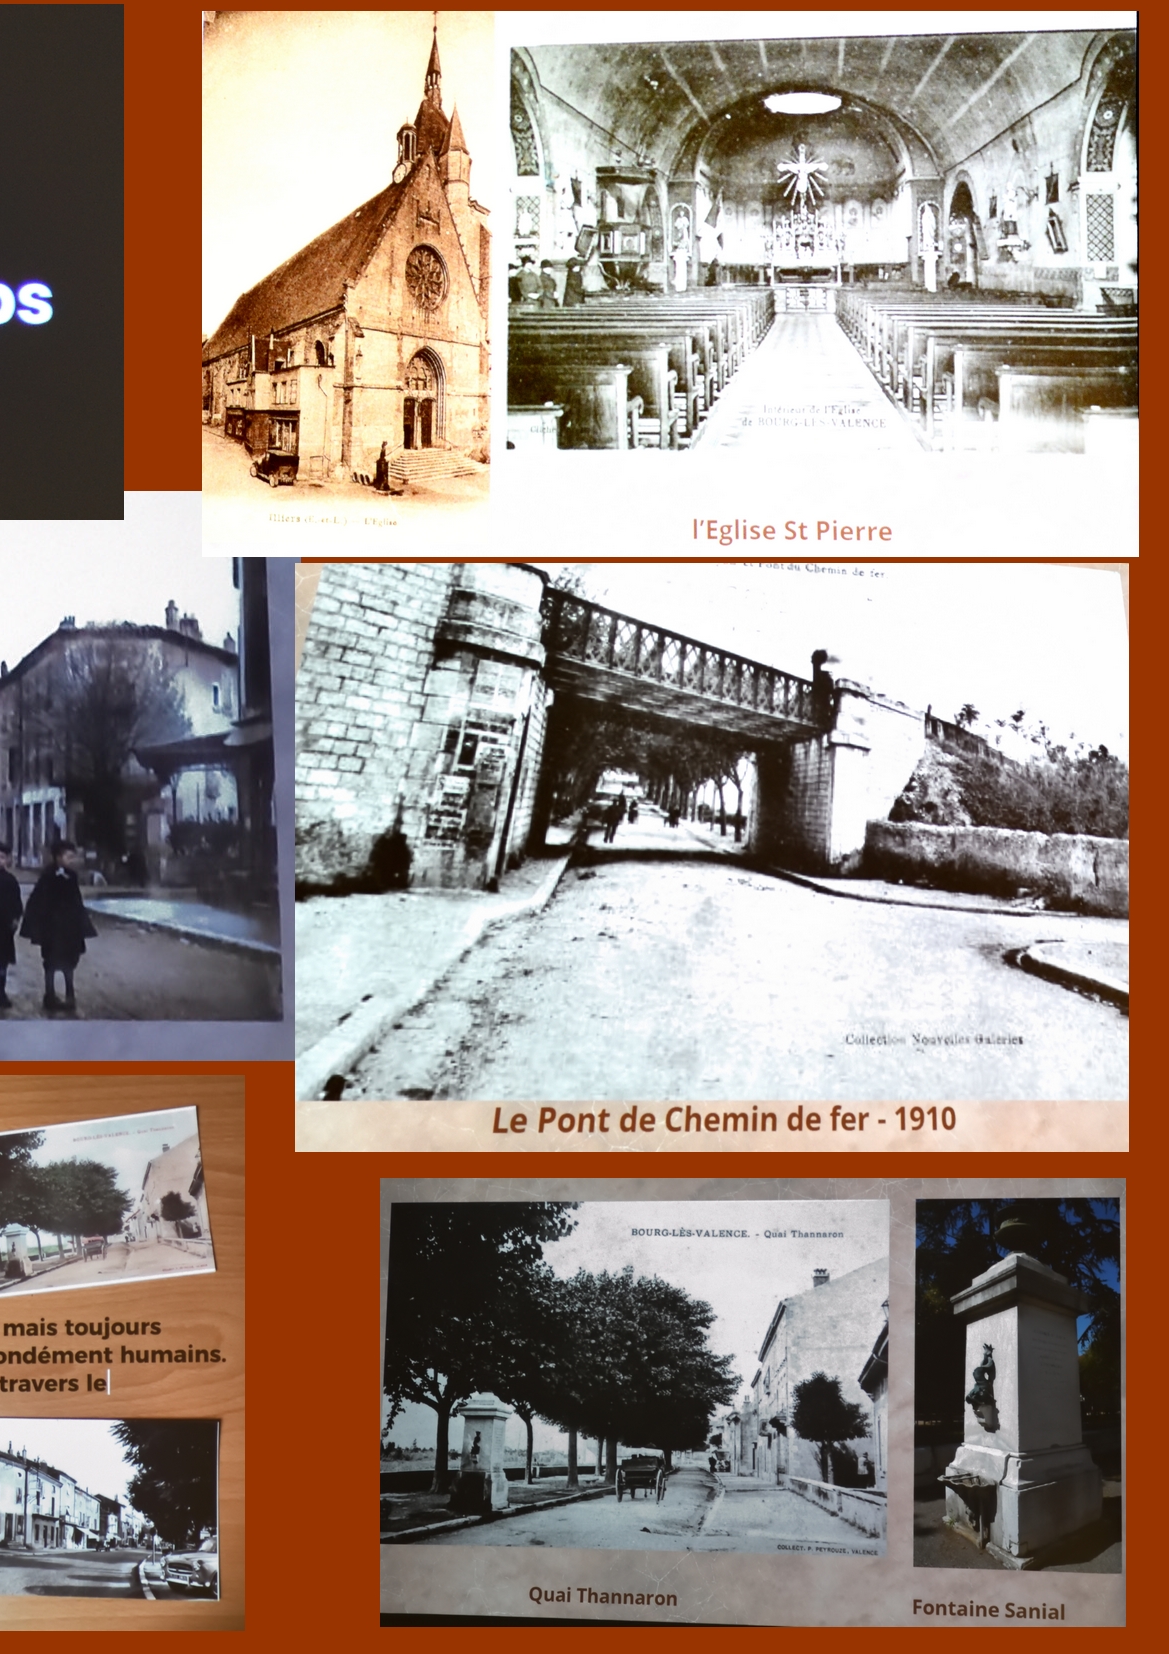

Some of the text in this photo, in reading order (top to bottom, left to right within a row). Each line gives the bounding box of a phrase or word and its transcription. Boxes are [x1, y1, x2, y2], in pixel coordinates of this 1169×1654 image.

[785, 520, 809, 541] St
[817, 520, 892, 542] Pierre
[492, 1108, 528, 1133] Le
[538, 1107, 610, 1133] Pont
[618, 1105, 657, 1132] de
[665, 1106, 778, 1132] Chemin
[786, 1105, 822, 1131] de
[829, 1105, 870, 1131] fer
[894, 1107, 957, 1131] 1910
[764, 1230, 787, 1239] Quai
[791, 1230, 844, 1239] Thannaron
[3, 1317, 162, 1341] mais toujours
[120, 1345, 227, 1364] humains.
[86, 1373, 108, 1392] le
[852, 1549, 879, 1557] VALENCE
[529, 1586, 678, 1607] Quai Thannaron
[913, 1599, 1065, 1621] Fontaine Sanial
